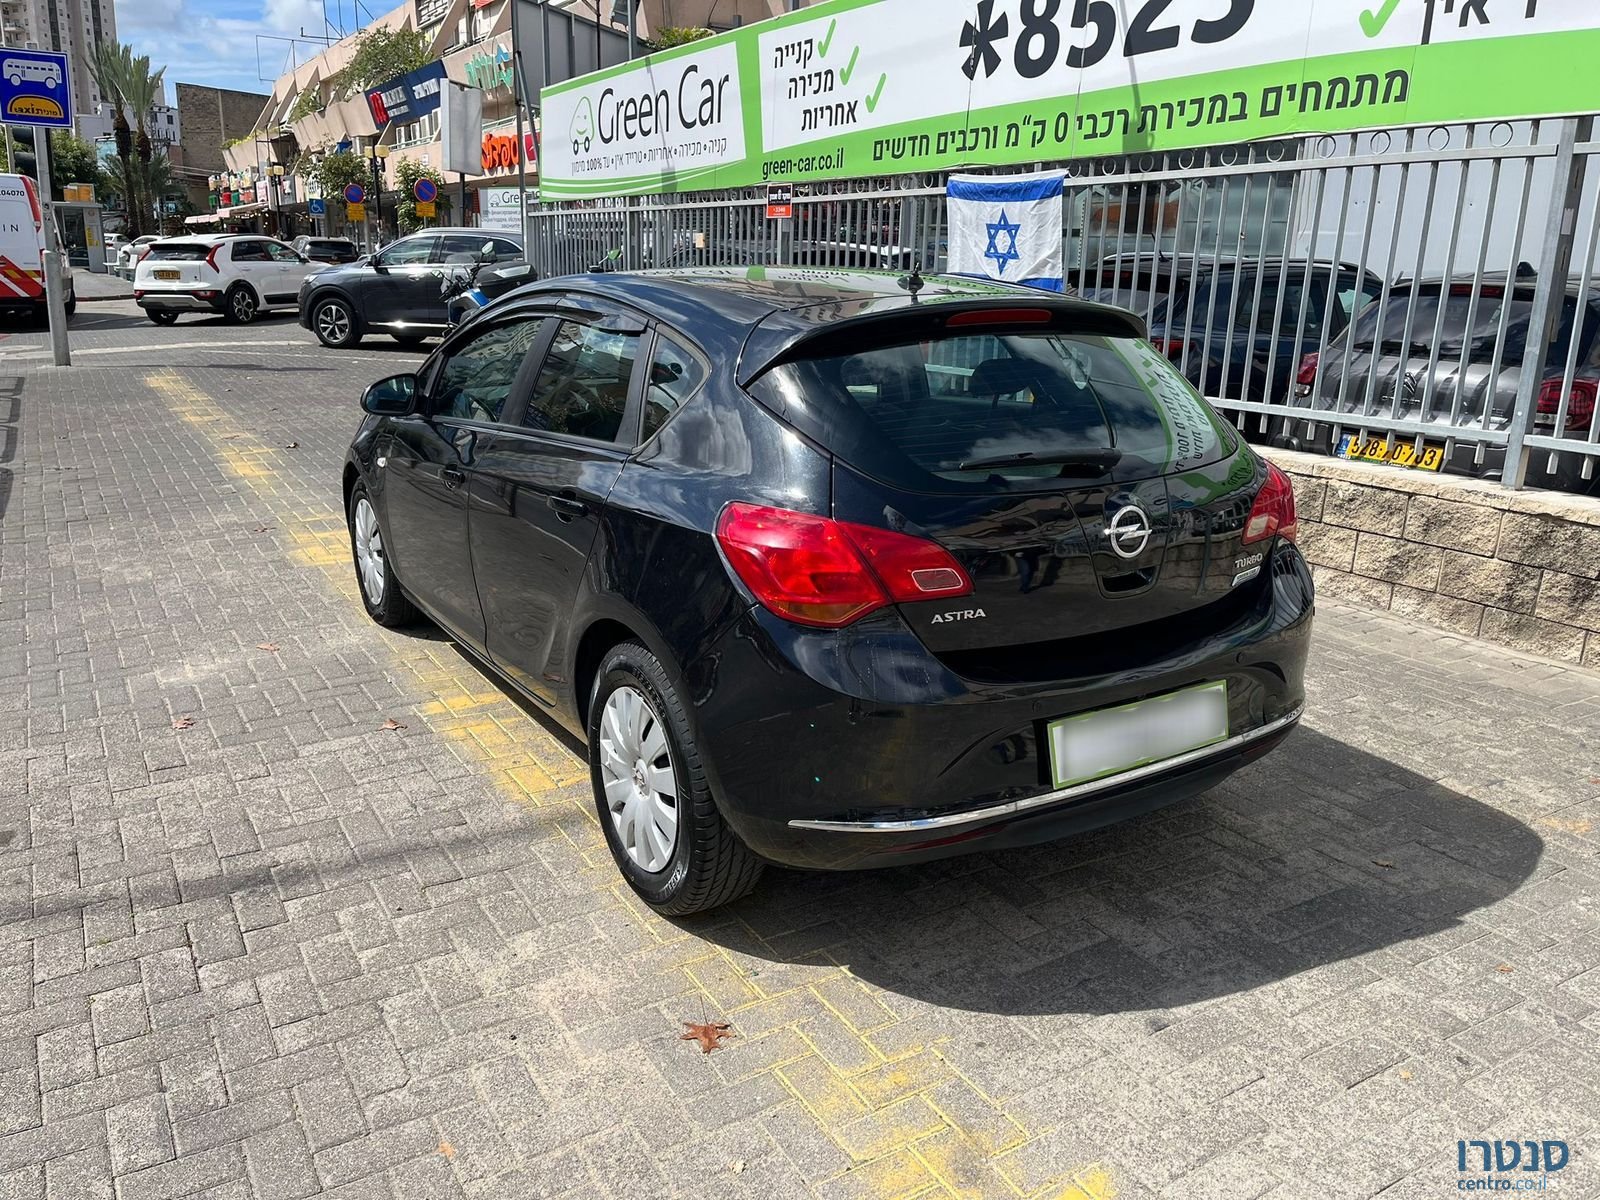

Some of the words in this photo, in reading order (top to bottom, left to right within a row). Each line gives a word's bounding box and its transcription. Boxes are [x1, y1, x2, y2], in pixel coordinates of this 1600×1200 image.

[774, 38, 813, 69] קנייה
[788, 68, 834, 99] מכירה
[1260, 69, 1409, 118] מתמחים
[14, 103, 34, 114] taxi
[598, 87, 669, 144] Green
[678, 64, 730, 130] Car
[801, 100, 858, 131] אחריות
[1137, 91, 1248, 133] במכירת
[1054, 112, 1068, 144] 0
[1076, 108, 1129, 140] רכבי
[648, 146, 672, 162] אחריות
[679, 141, 702, 157] מכירה
[708, 138, 727, 154] קניה
[872, 134, 930, 161] חדשים
[936, 126, 998, 154] ורכבים
[586, 158, 602, 171] 100%
[762, 148, 844, 180] green-car.co.il
[502, 191, 520, 203] Gre
[1235, 553, 1263, 568] TURBO
[931, 608, 986, 624] ASTRA
